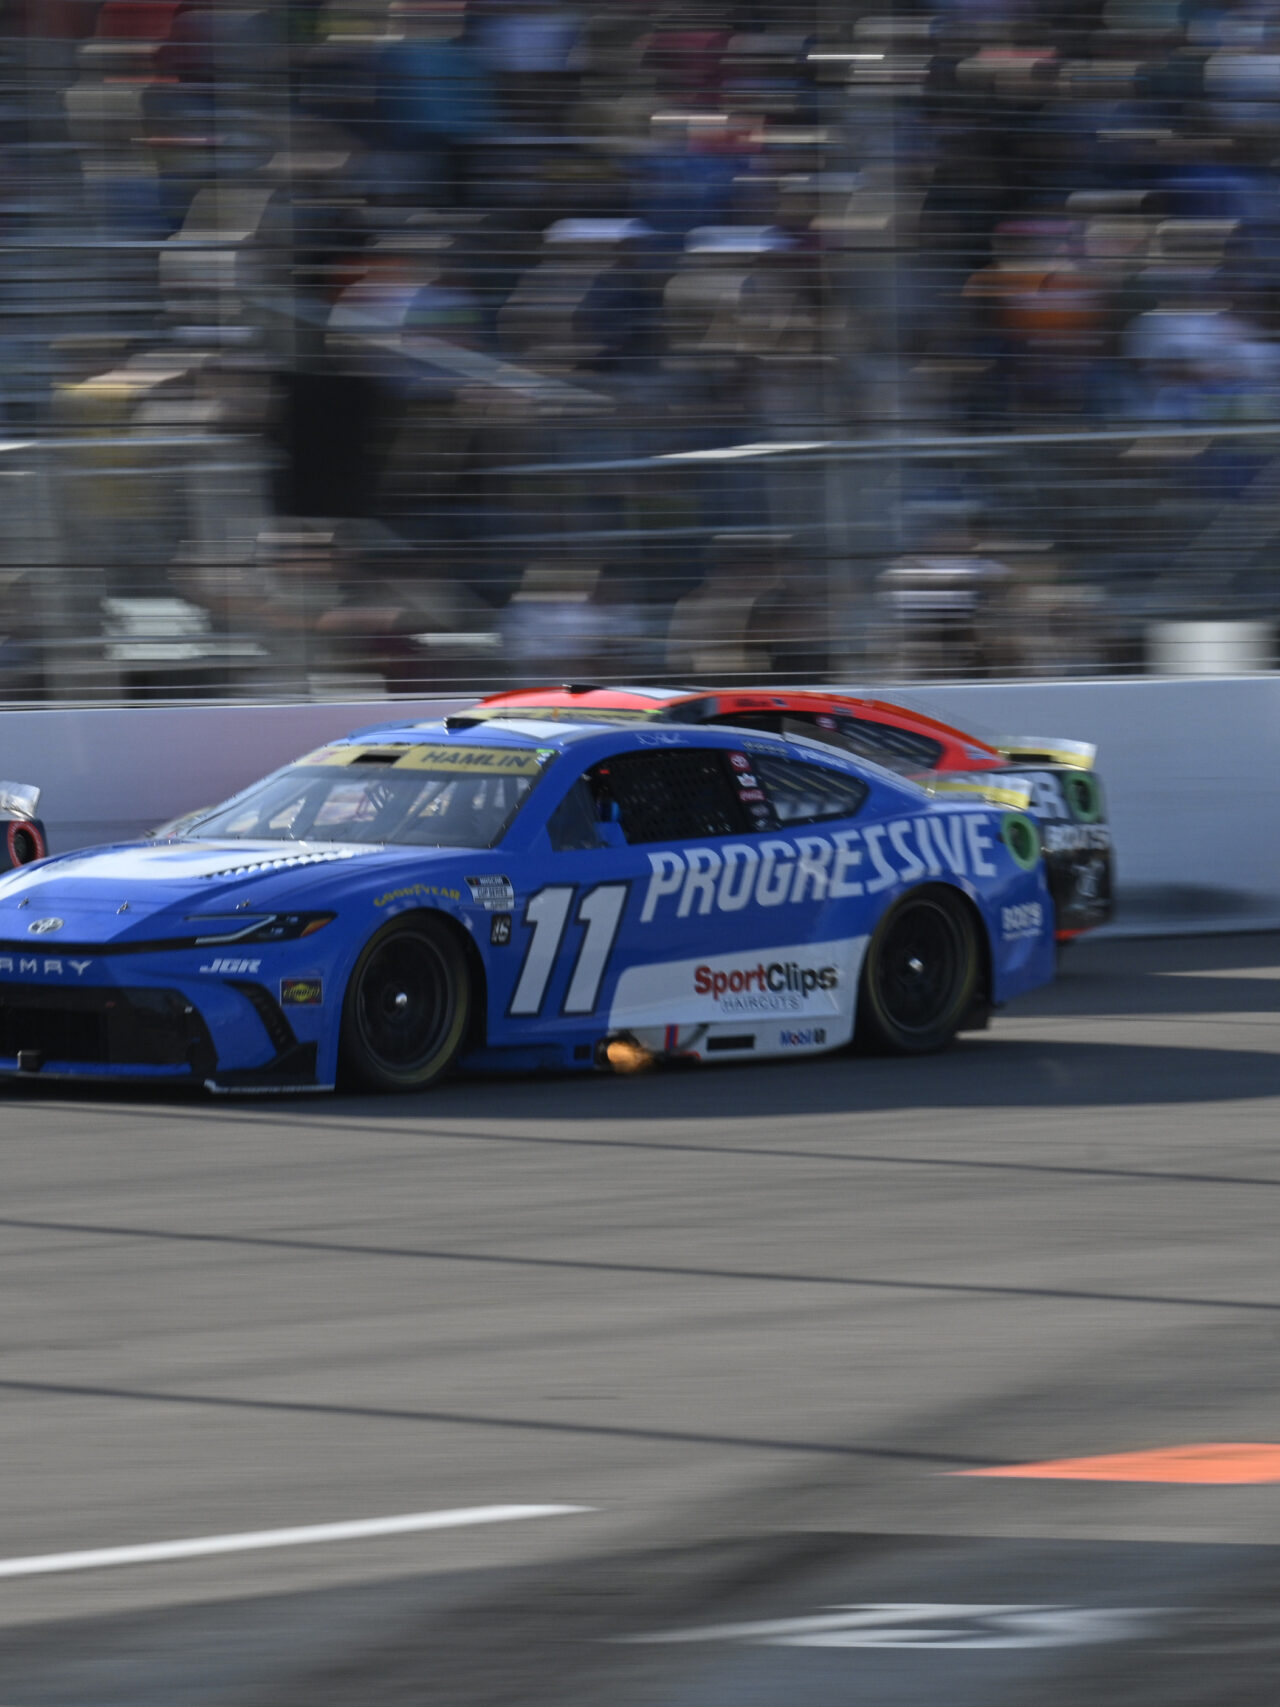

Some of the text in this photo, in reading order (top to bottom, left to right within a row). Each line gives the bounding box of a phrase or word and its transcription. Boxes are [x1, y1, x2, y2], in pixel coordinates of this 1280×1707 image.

[420, 750, 532, 769] HAMLIN
[640, 812, 998, 924] PROGRESSIVE
[373, 882, 461, 907] GOODYEAR
[509, 884, 628, 1016] 11
[199, 958, 263, 974] JGR
[694, 963, 839, 1001] SportClips
[723, 995, 801, 1012] HAIRCUTS
